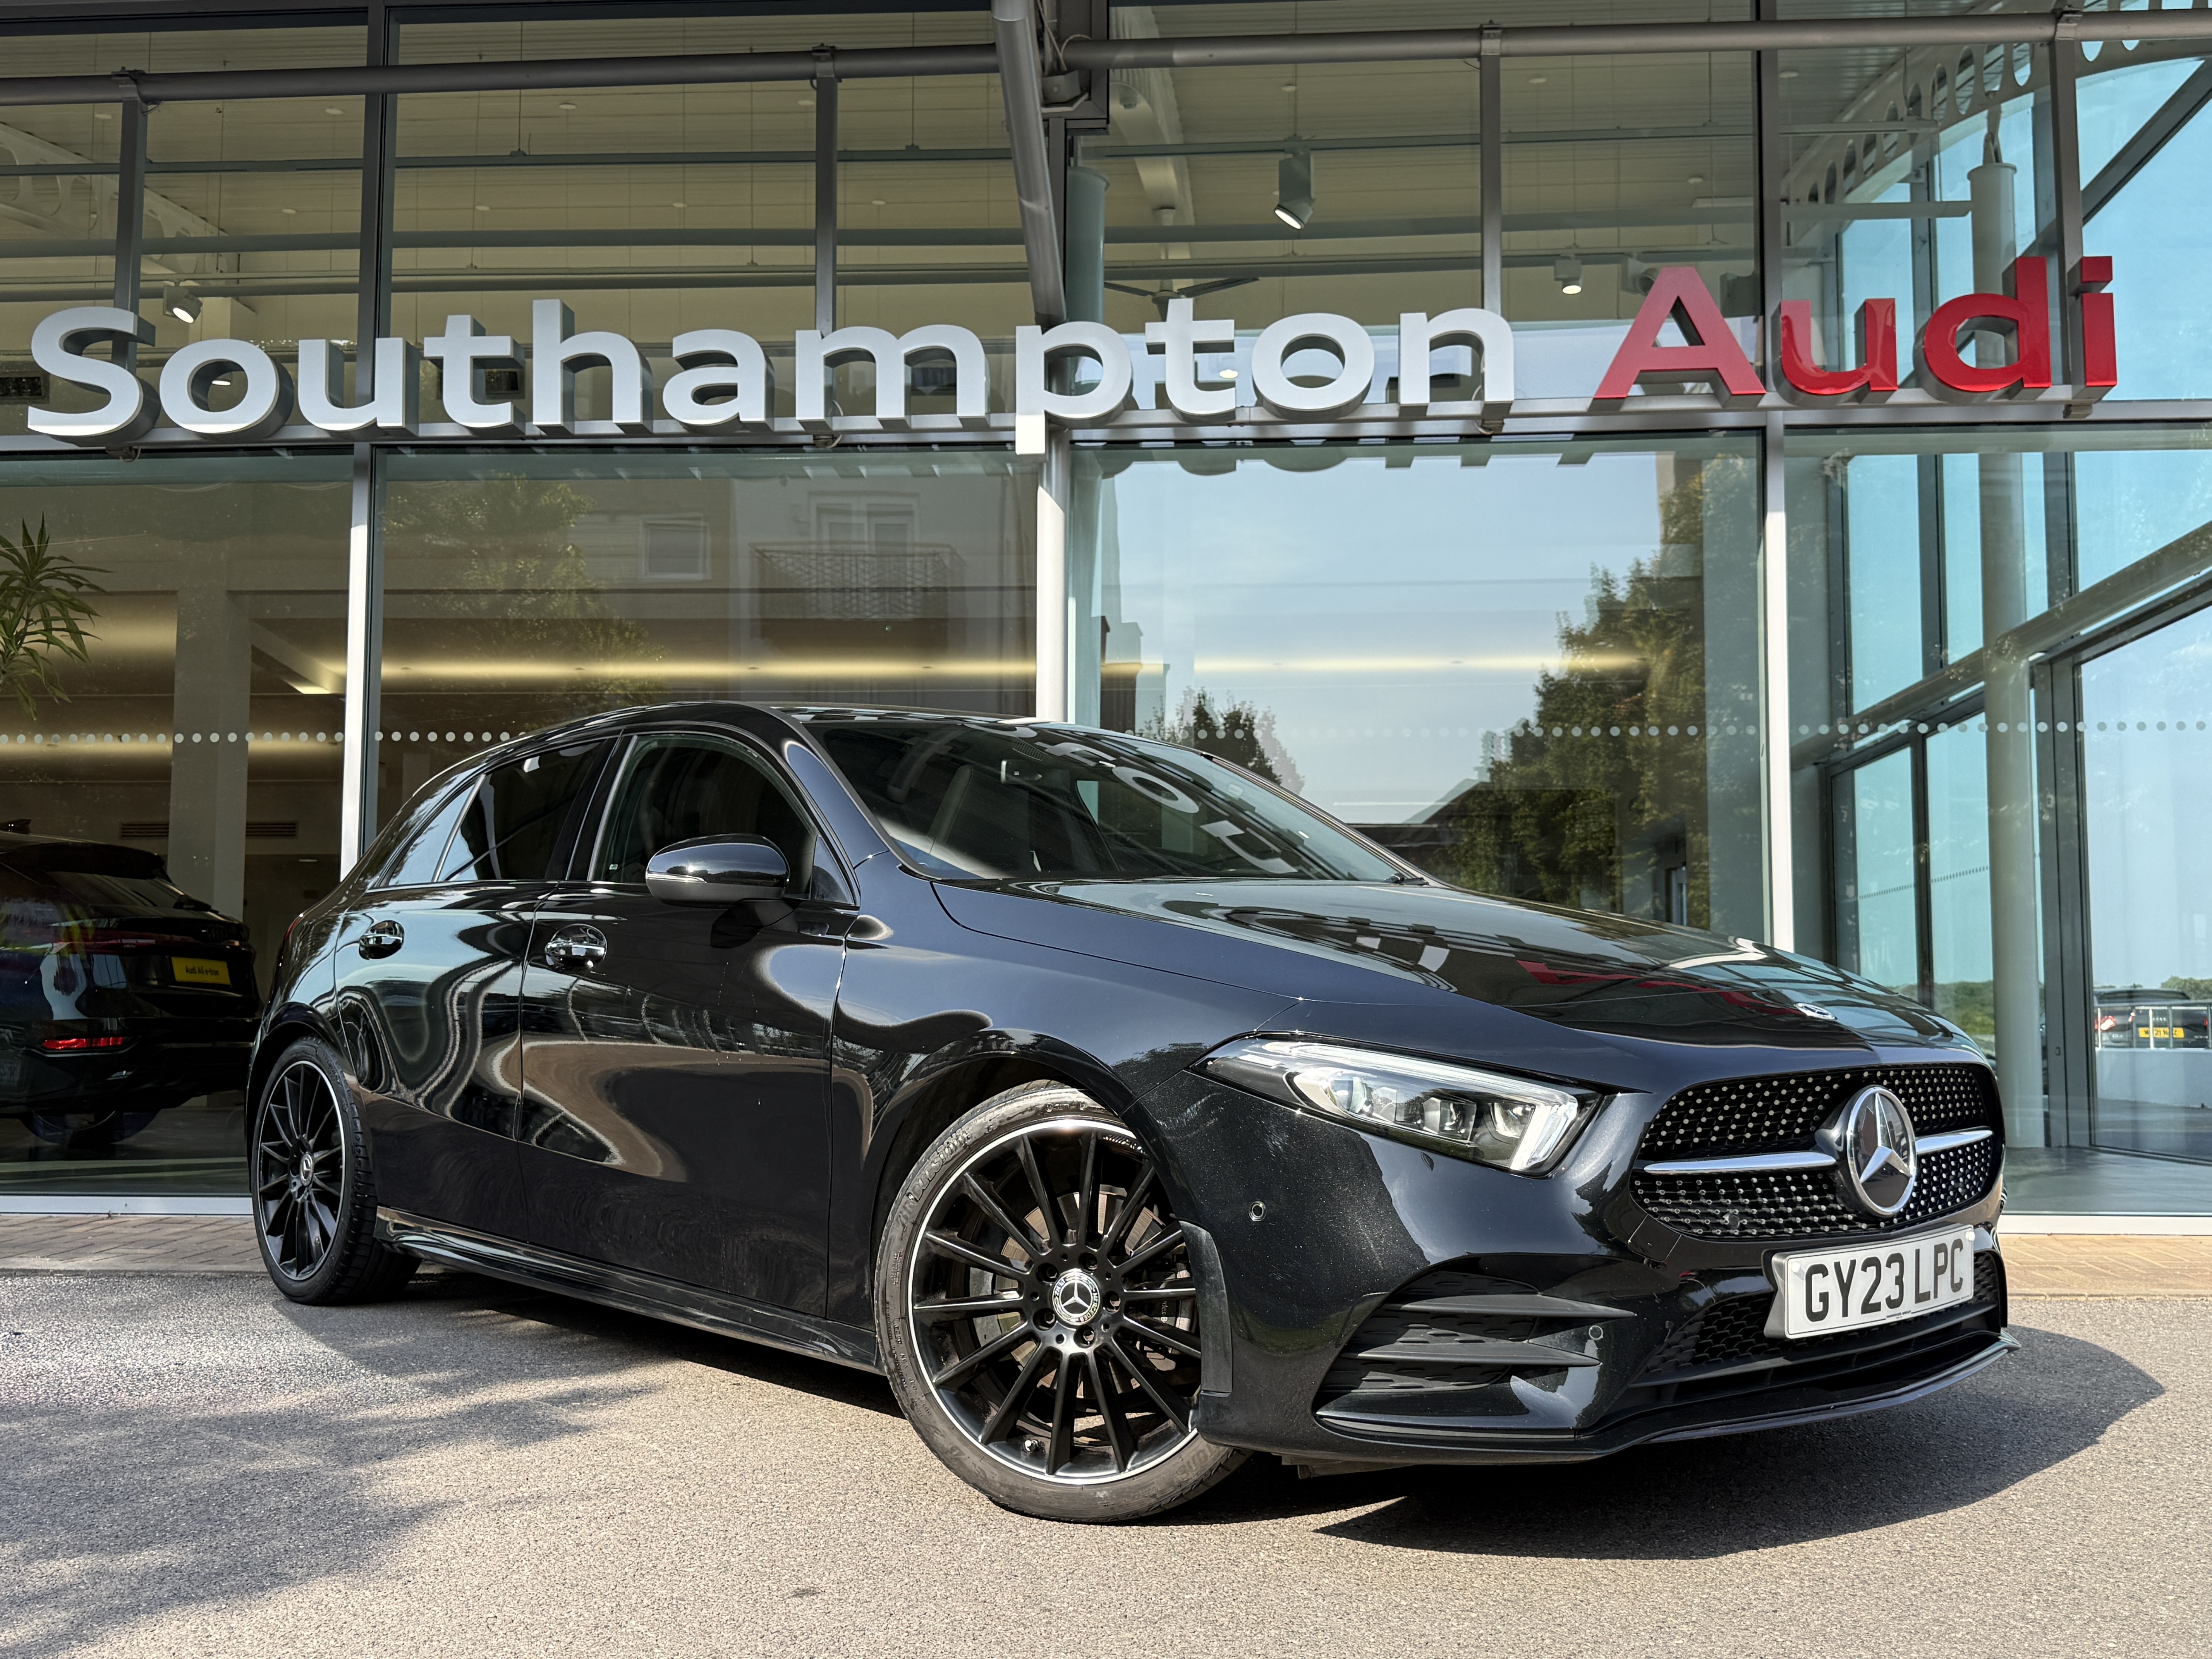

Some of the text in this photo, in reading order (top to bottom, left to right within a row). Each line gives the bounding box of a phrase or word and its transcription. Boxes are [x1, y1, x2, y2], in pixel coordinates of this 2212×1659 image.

[28, 256, 2118, 455] Southampton Audi
[1805, 1238, 1963, 1322] GY23 LPC
